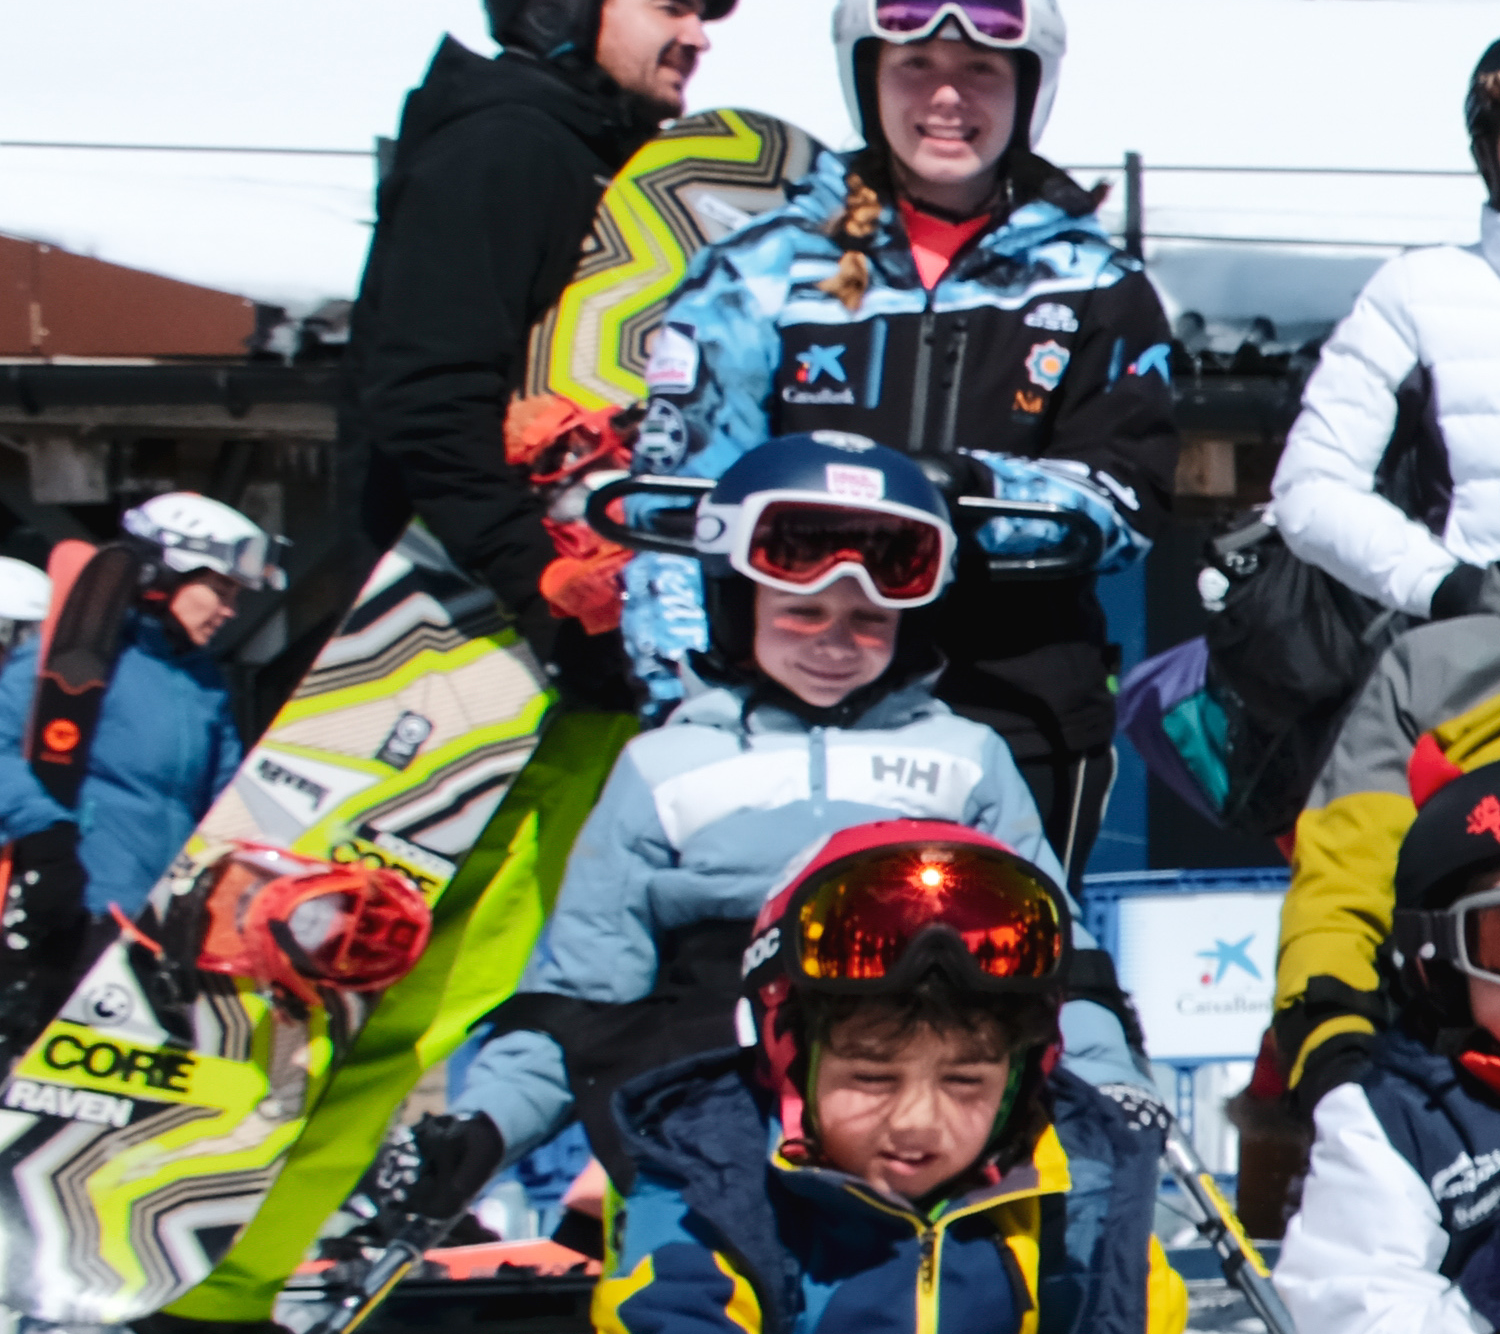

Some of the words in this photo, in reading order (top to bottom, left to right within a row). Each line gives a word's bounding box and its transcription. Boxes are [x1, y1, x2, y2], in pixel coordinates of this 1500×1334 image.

[871, 754, 941, 795] HH
[43, 1032, 198, 1095] CORE
[4, 1078, 135, 1128] RAVEN
